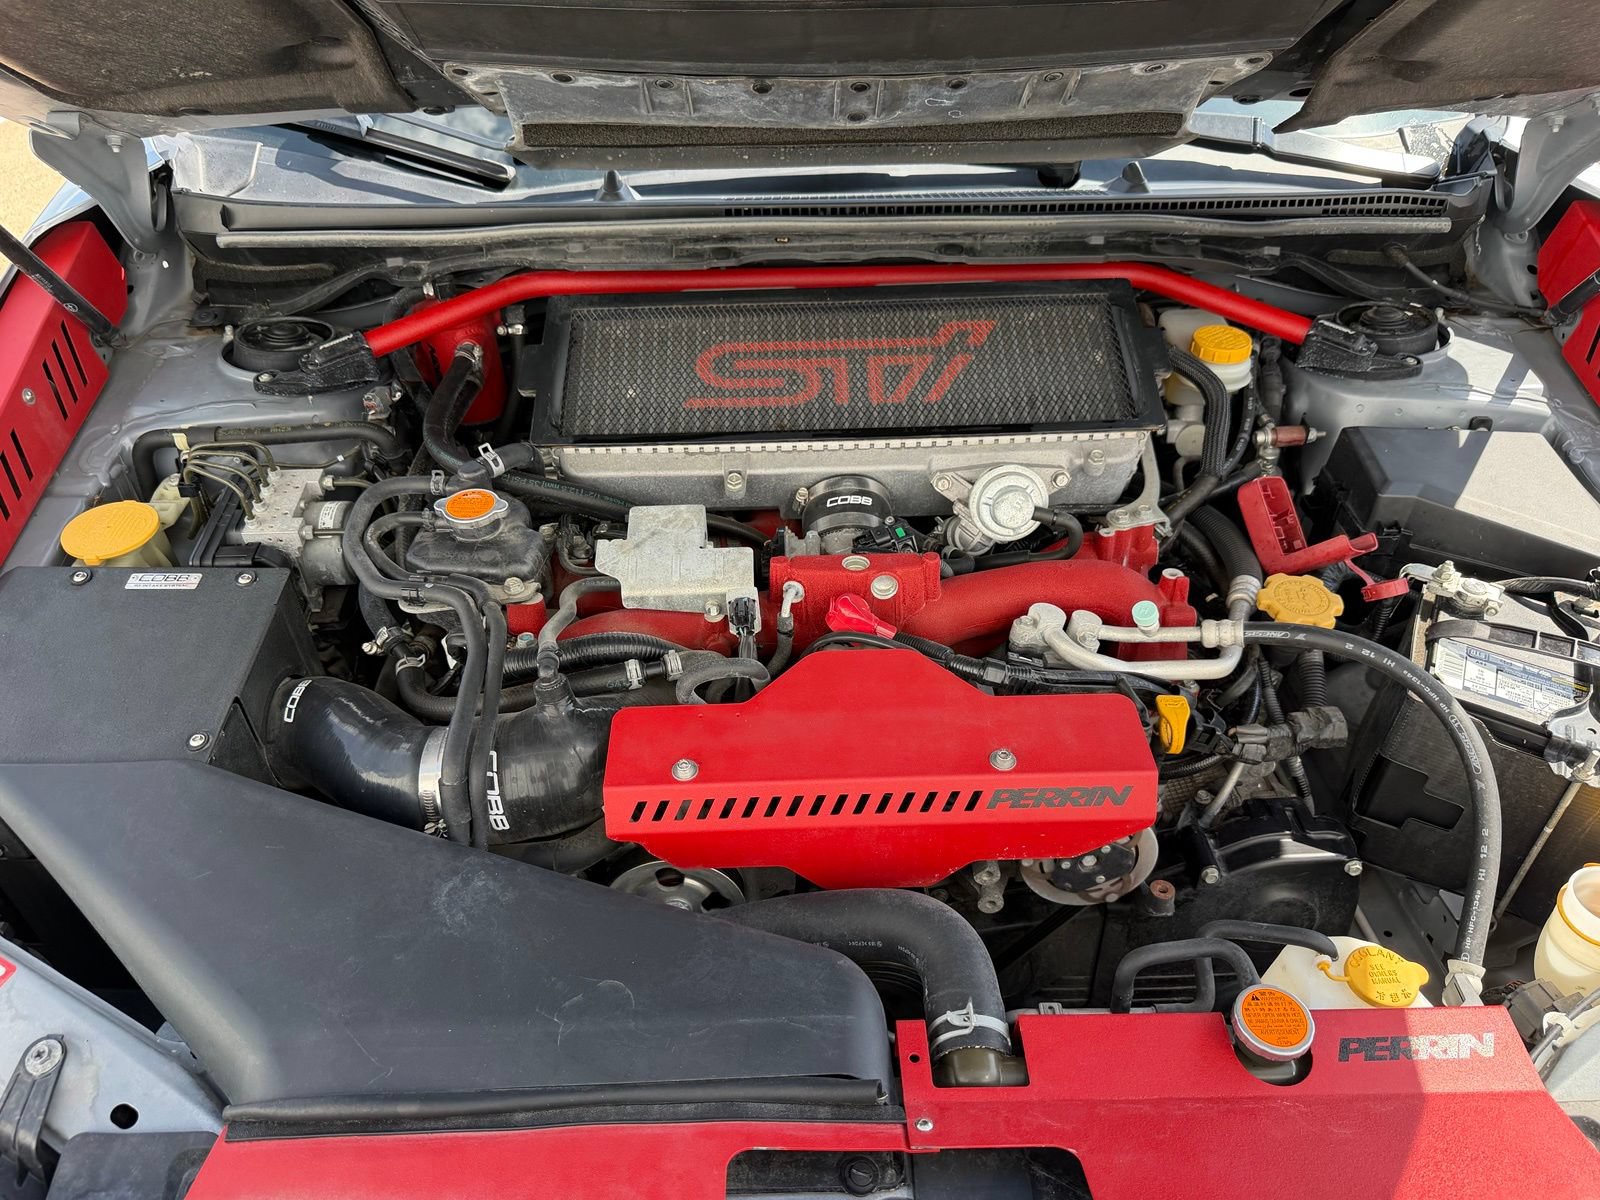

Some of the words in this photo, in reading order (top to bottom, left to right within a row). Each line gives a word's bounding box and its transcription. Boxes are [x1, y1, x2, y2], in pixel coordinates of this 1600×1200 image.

[826, 495, 873, 508] COBB
[1345, 642, 1355, 650] 2
[1361, 648, 1376, 659] 12
[1382, 657, 1396, 668] HI
[1403, 669, 1440, 702] HFC-134a
[283, 679, 313, 723] COBB
[1439, 702, 1450, 714] HP
[986, 785, 1134, 810] PERRIN
[1482, 828, 1489, 837] 2
[1480, 844, 1488, 859] 12
[1477, 869, 1486, 881] HI
[1467, 890, 1481, 934] HFC-134a
[1464, 936, 1471, 949] HP
[1369, 963, 1385, 971] SEE
[1370, 977, 1401, 985] MANUAL
[1338, 1032, 1495, 1063] PERRIN
